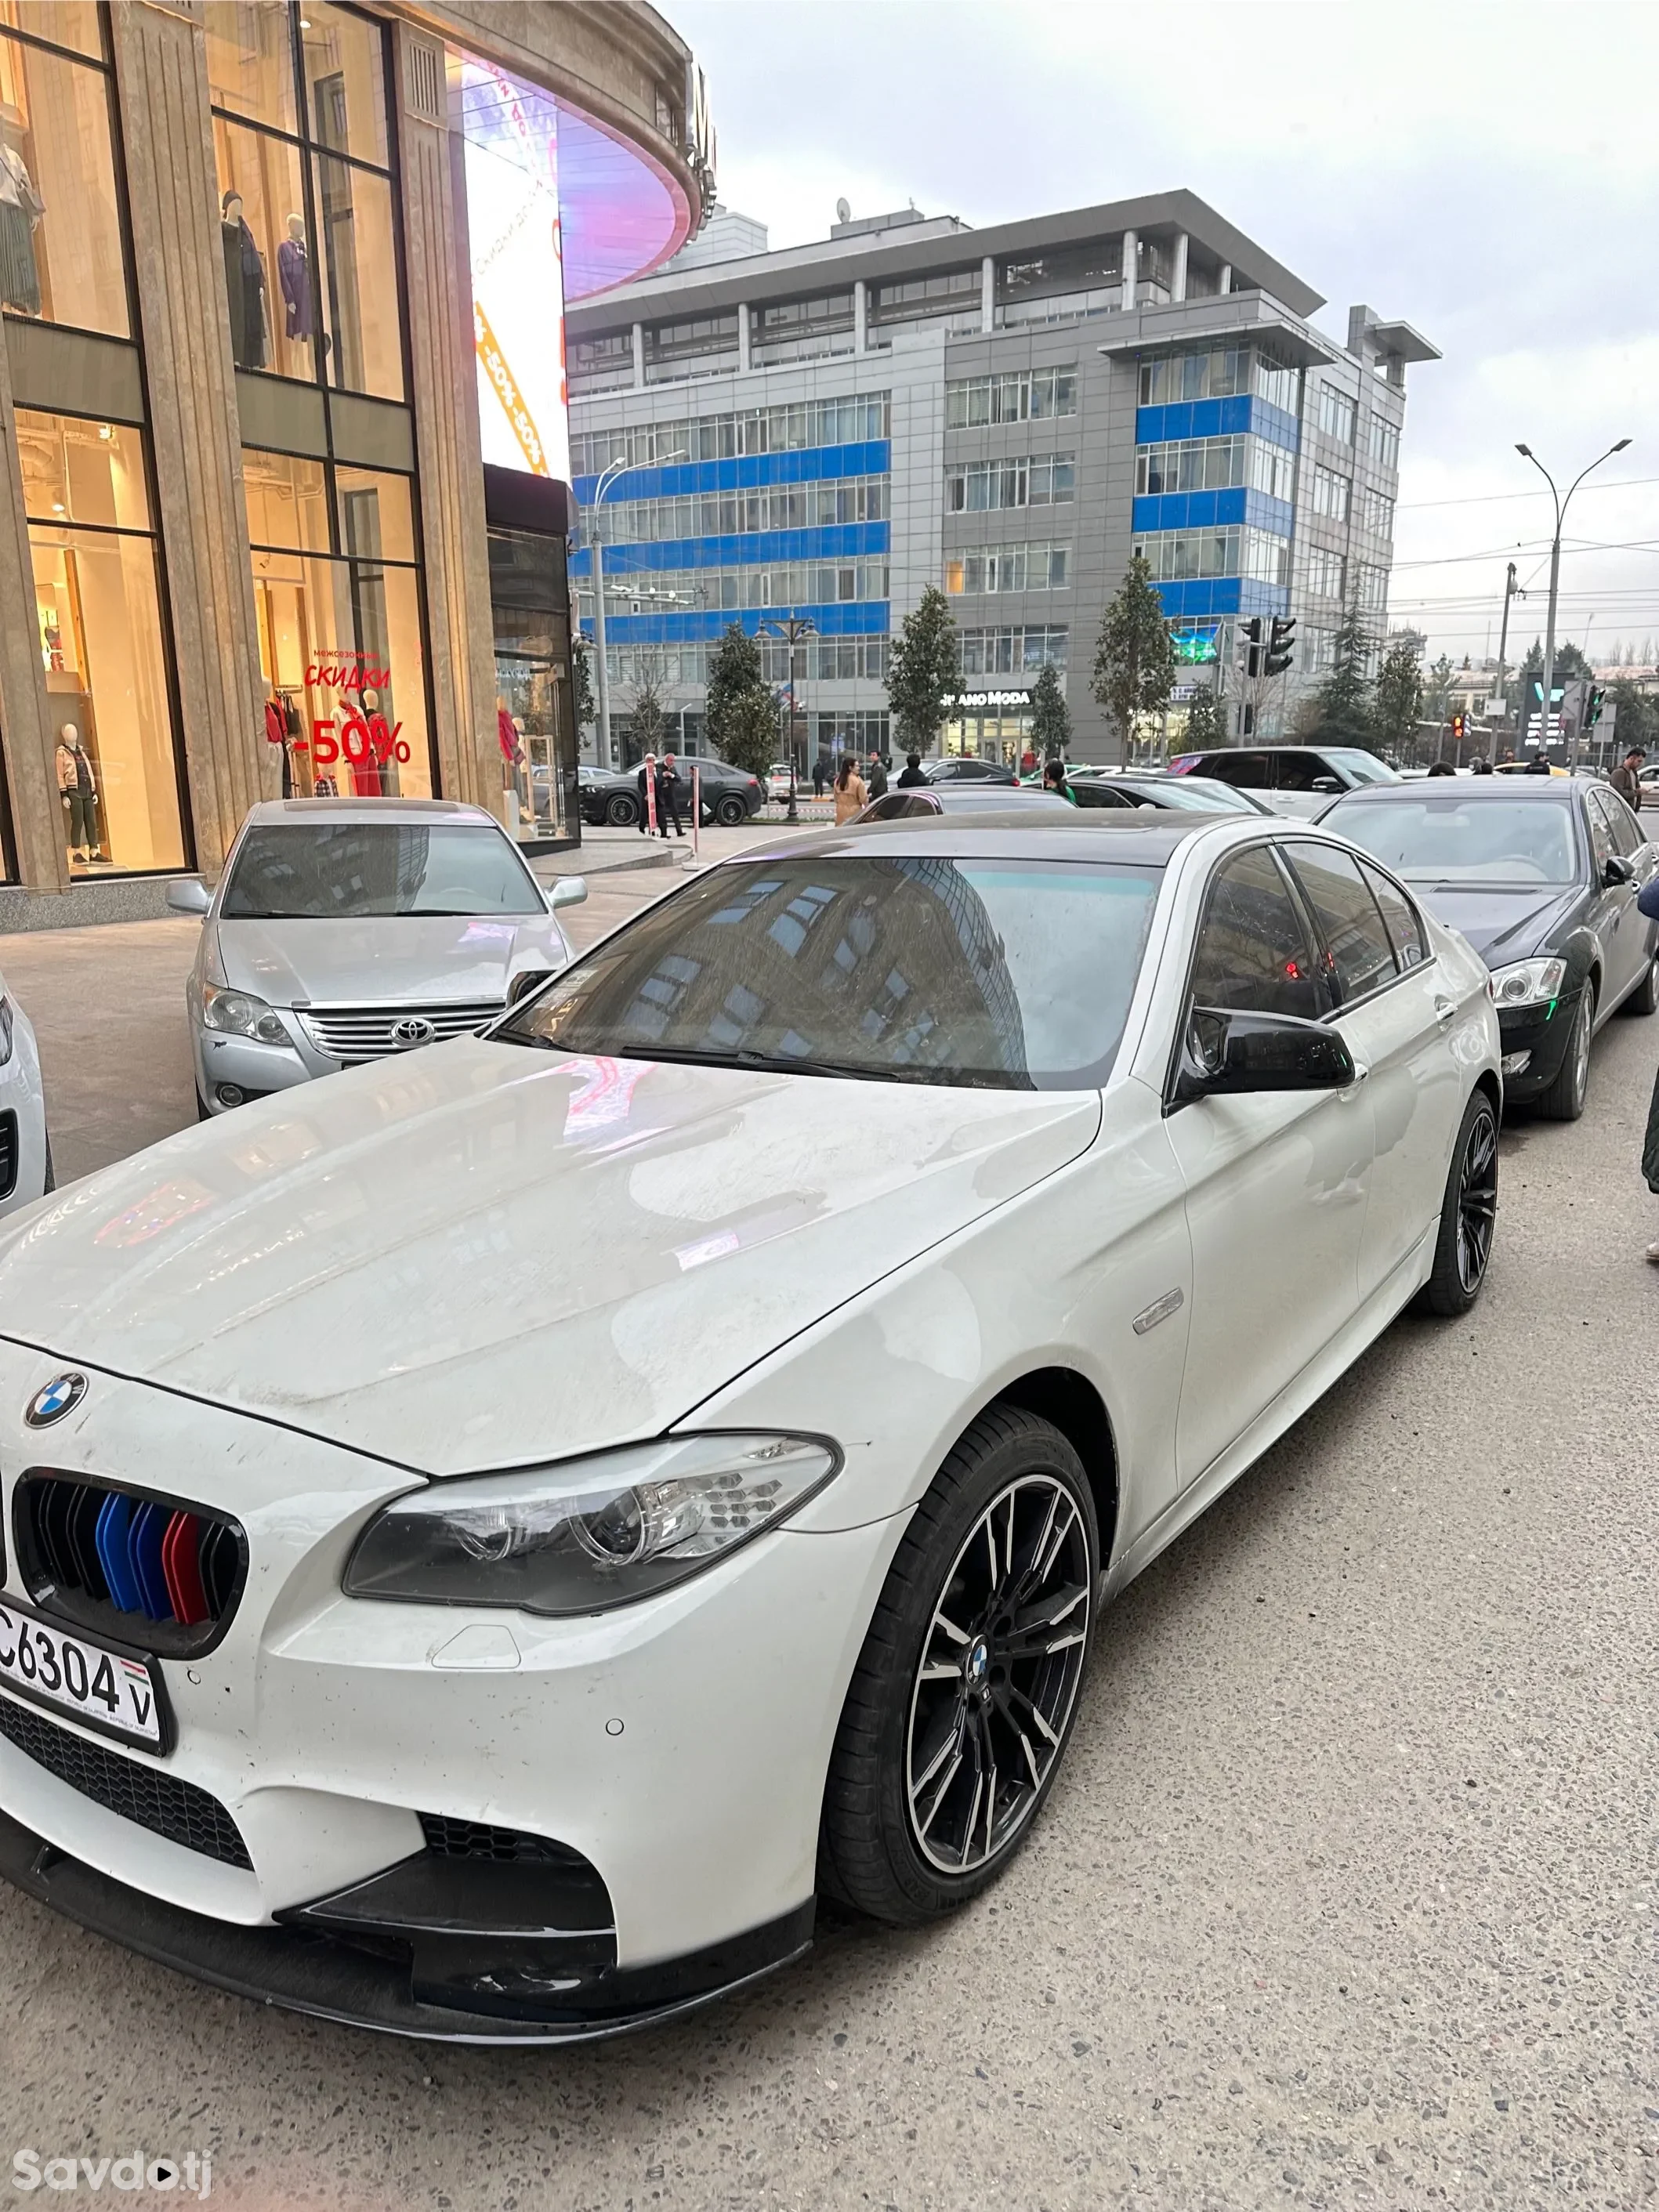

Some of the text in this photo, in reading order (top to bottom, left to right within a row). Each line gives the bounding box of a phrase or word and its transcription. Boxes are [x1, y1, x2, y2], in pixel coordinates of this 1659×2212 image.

[484, 345, 542, 465] -50% -50%
[304, 664, 391, 694] СКИДКИ
[988, 691, 1031, 705] MODA
[294, 719, 411, 764] -50%
[129, 1683, 150, 1726] V
